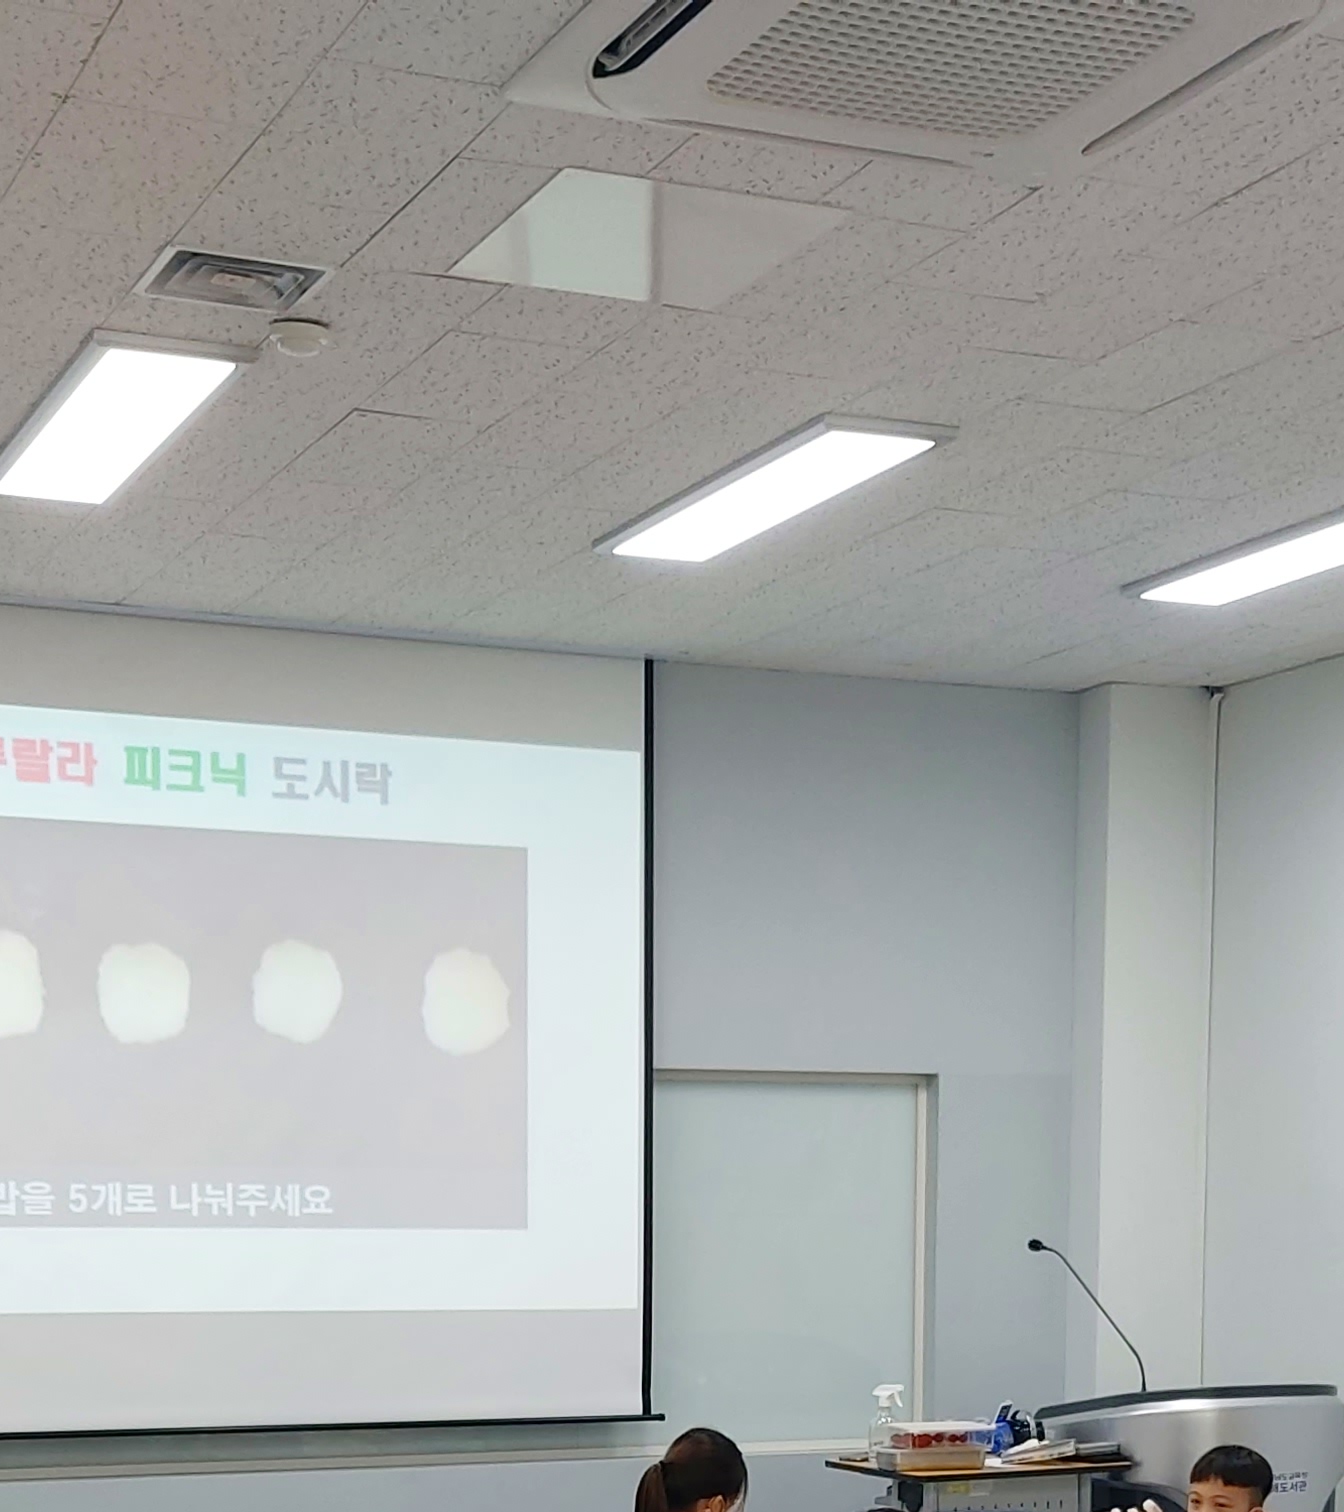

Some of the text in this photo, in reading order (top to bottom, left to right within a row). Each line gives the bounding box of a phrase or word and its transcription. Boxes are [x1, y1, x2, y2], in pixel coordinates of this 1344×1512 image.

[123, 745, 247, 797] 피크닉
[271, 756, 393, 805] 도시락
[68, 1181, 157, 1217] 5개로
[170, 1181, 334, 1218] 나눠주세요
